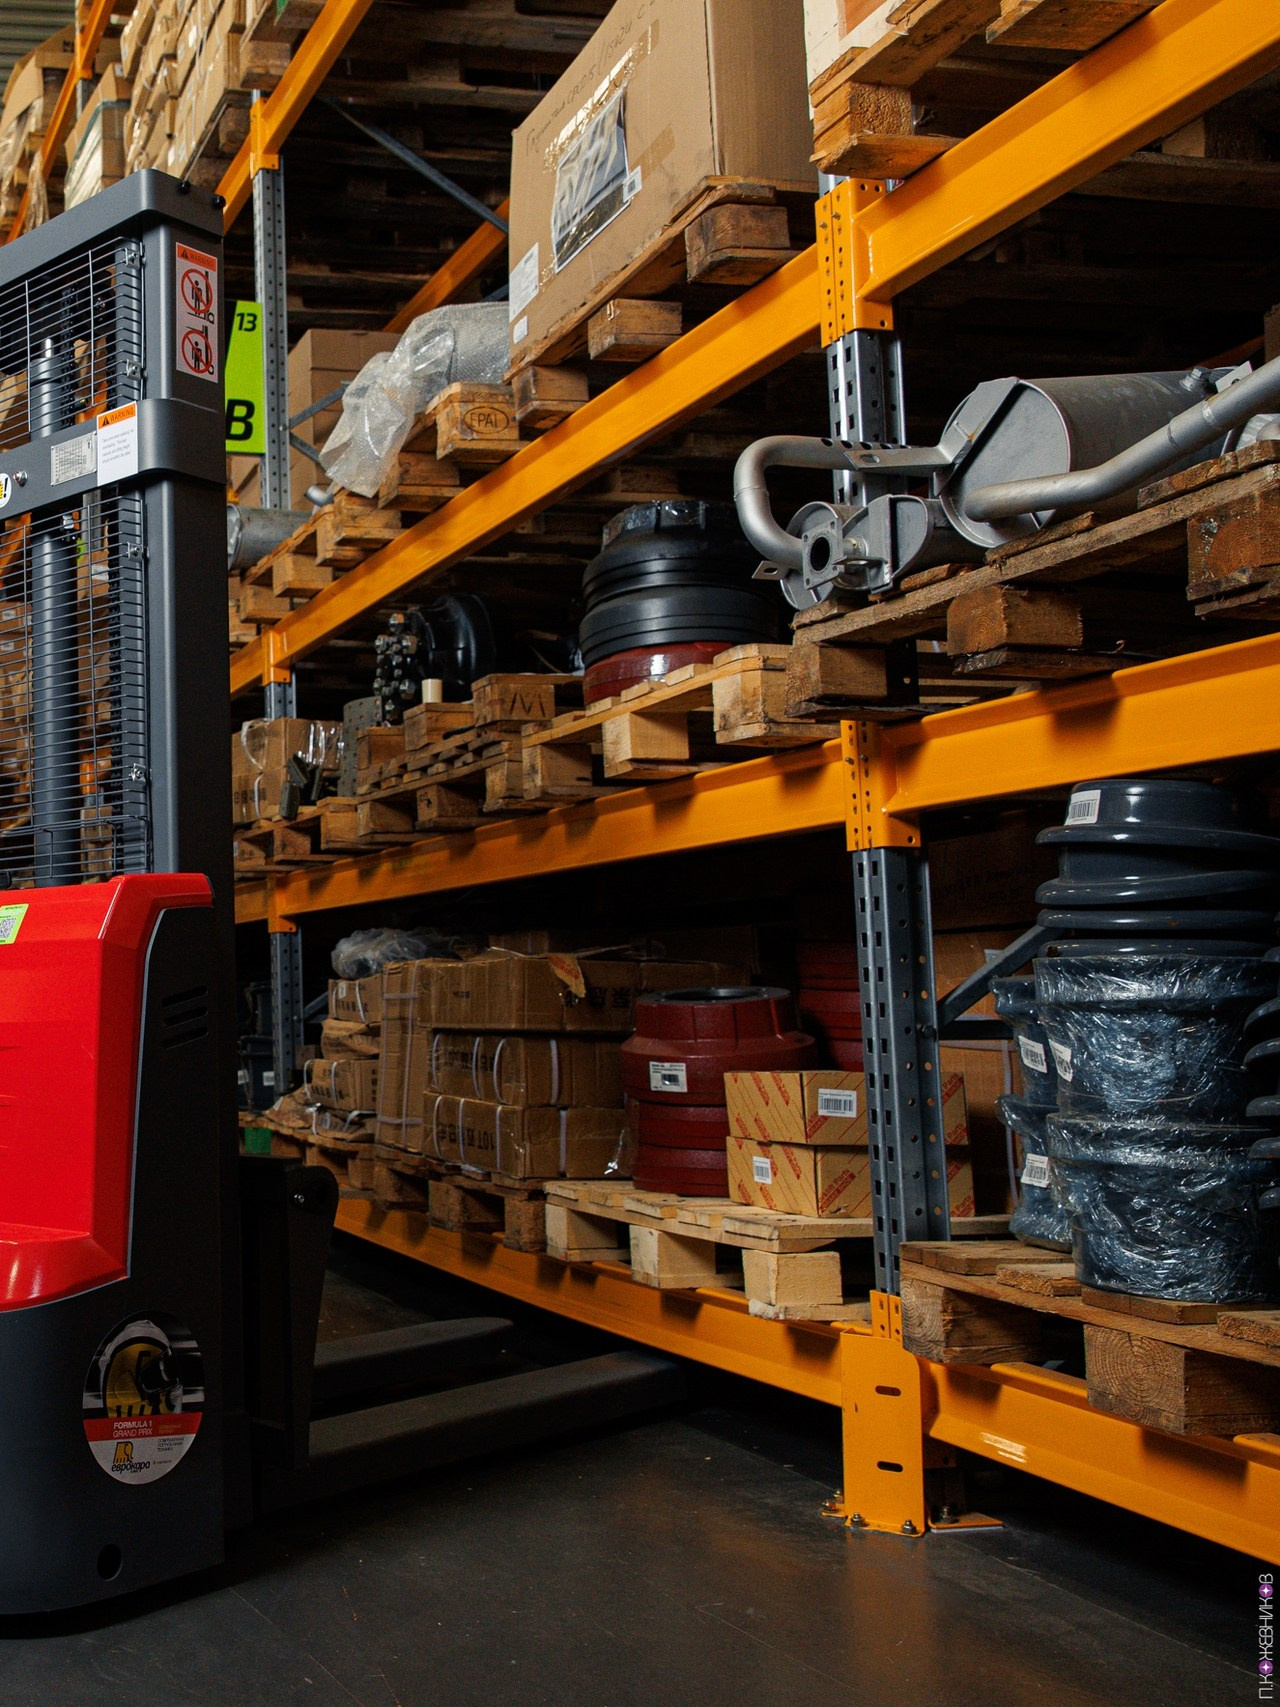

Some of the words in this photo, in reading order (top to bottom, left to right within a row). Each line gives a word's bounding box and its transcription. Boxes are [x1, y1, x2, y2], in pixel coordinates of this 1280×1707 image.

[236, 312, 258, 332] 13
[225, 398, 256, 441] B
[114, 1421, 148, 1429] FORMULA
[113, 1429, 137, 1437] GRAND
[138, 1428, 153, 1436] PRIX
